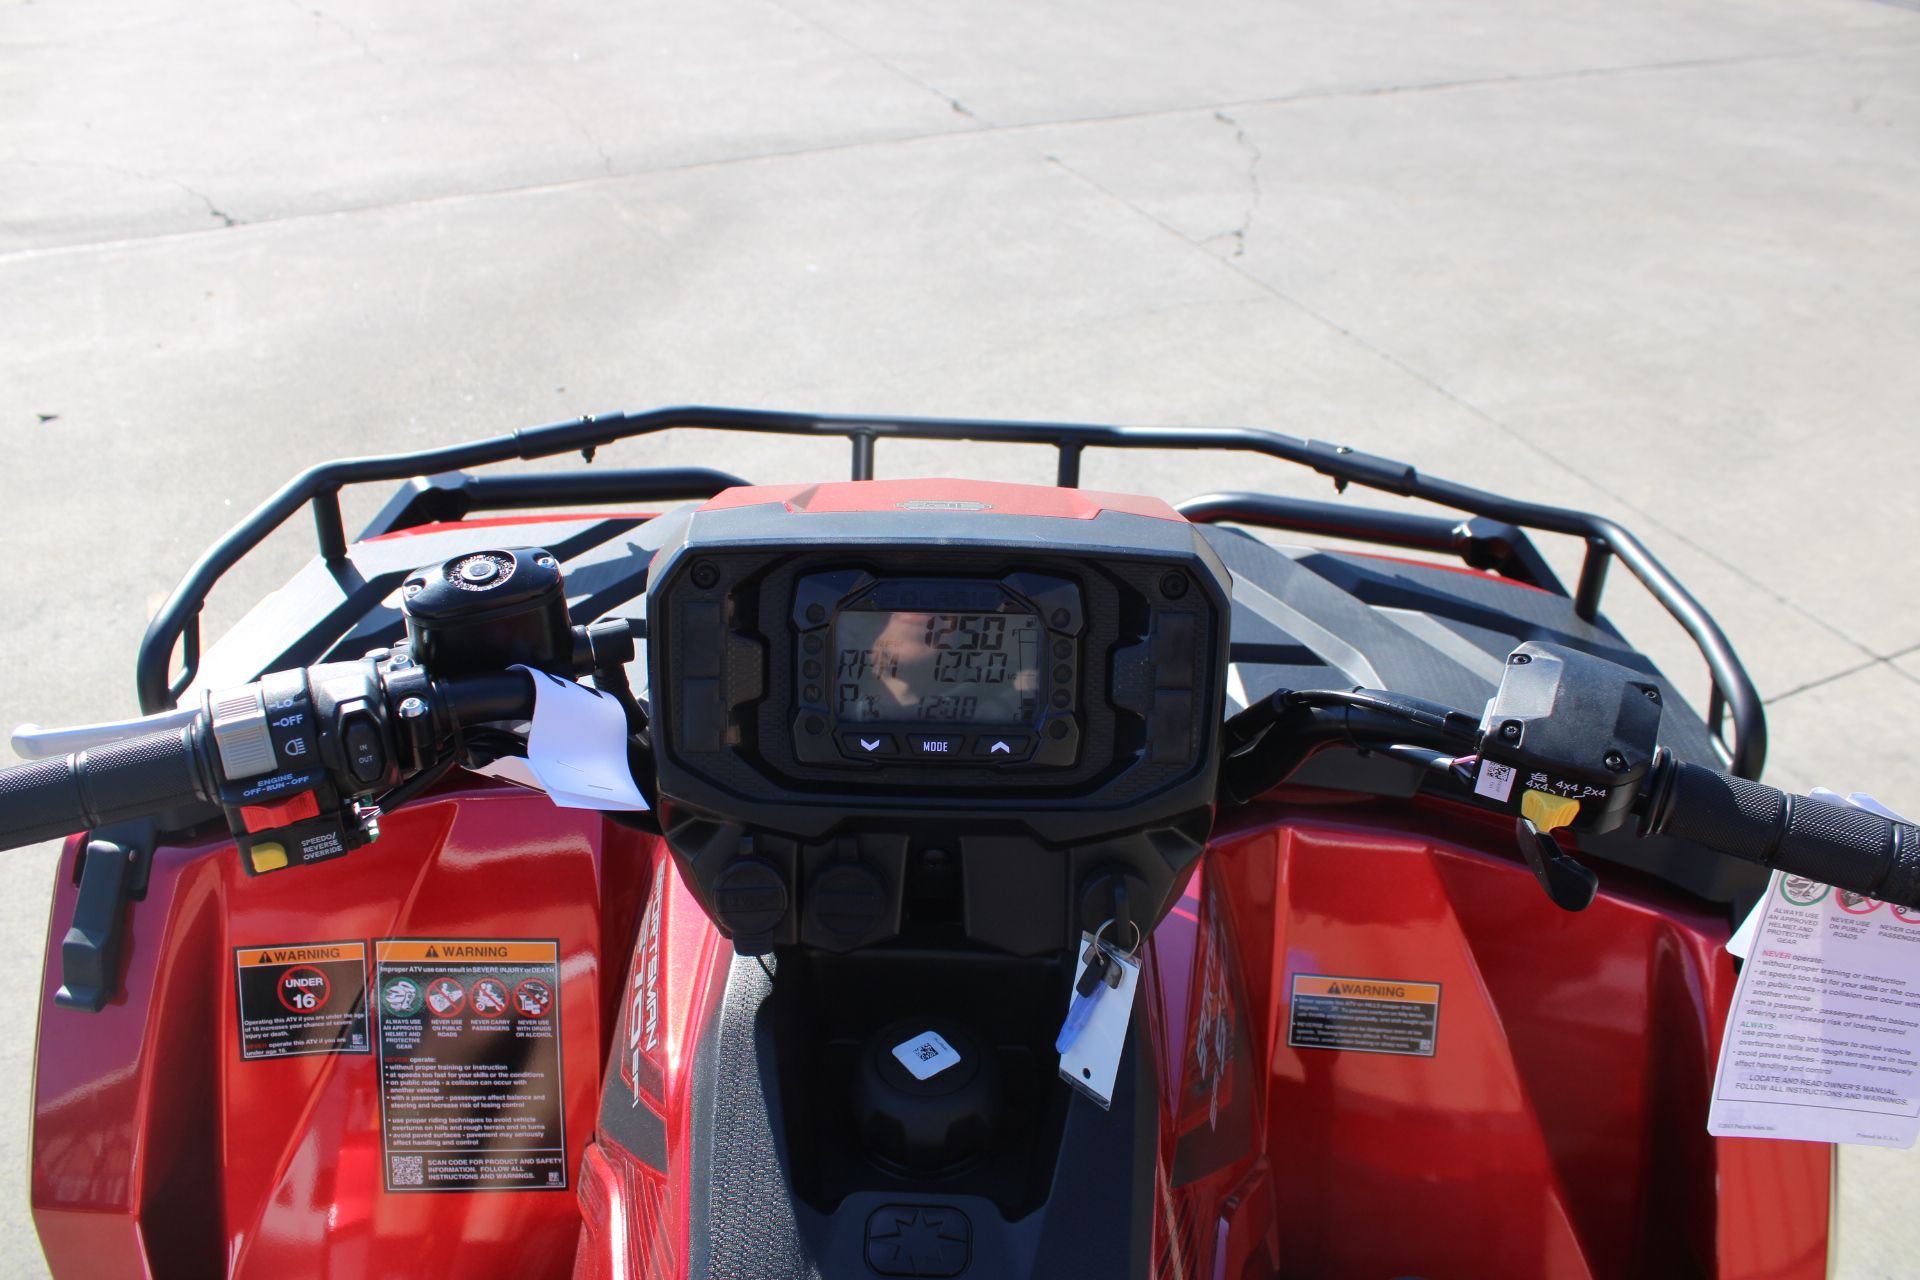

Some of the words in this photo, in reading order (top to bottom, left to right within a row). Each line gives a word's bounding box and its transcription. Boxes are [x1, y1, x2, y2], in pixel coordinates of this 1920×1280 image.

[925, 616, 1006, 649] 1250
[934, 652, 1008, 683] 1250
[840, 684, 859, 714] P
[923, 742, 948, 752] MODE
[359, 755, 373, 763] OUT
[257, 773, 293, 787] ENGINE
[301, 832, 337, 846] SPEEDO/
[303, 838, 338, 853] REVERSE
[303, 846, 343, 860] OVERRIDE
[274, 948, 340, 961] WARNING
[442, 946, 508, 957] WARNING
[1762, 950, 1791, 959] NEVER
[1792, 955, 1824, 964] operate:
[285, 977, 323, 988] UNDER
[1342, 984, 1405, 998] WARNING
[293, 994, 315, 1008] 16
